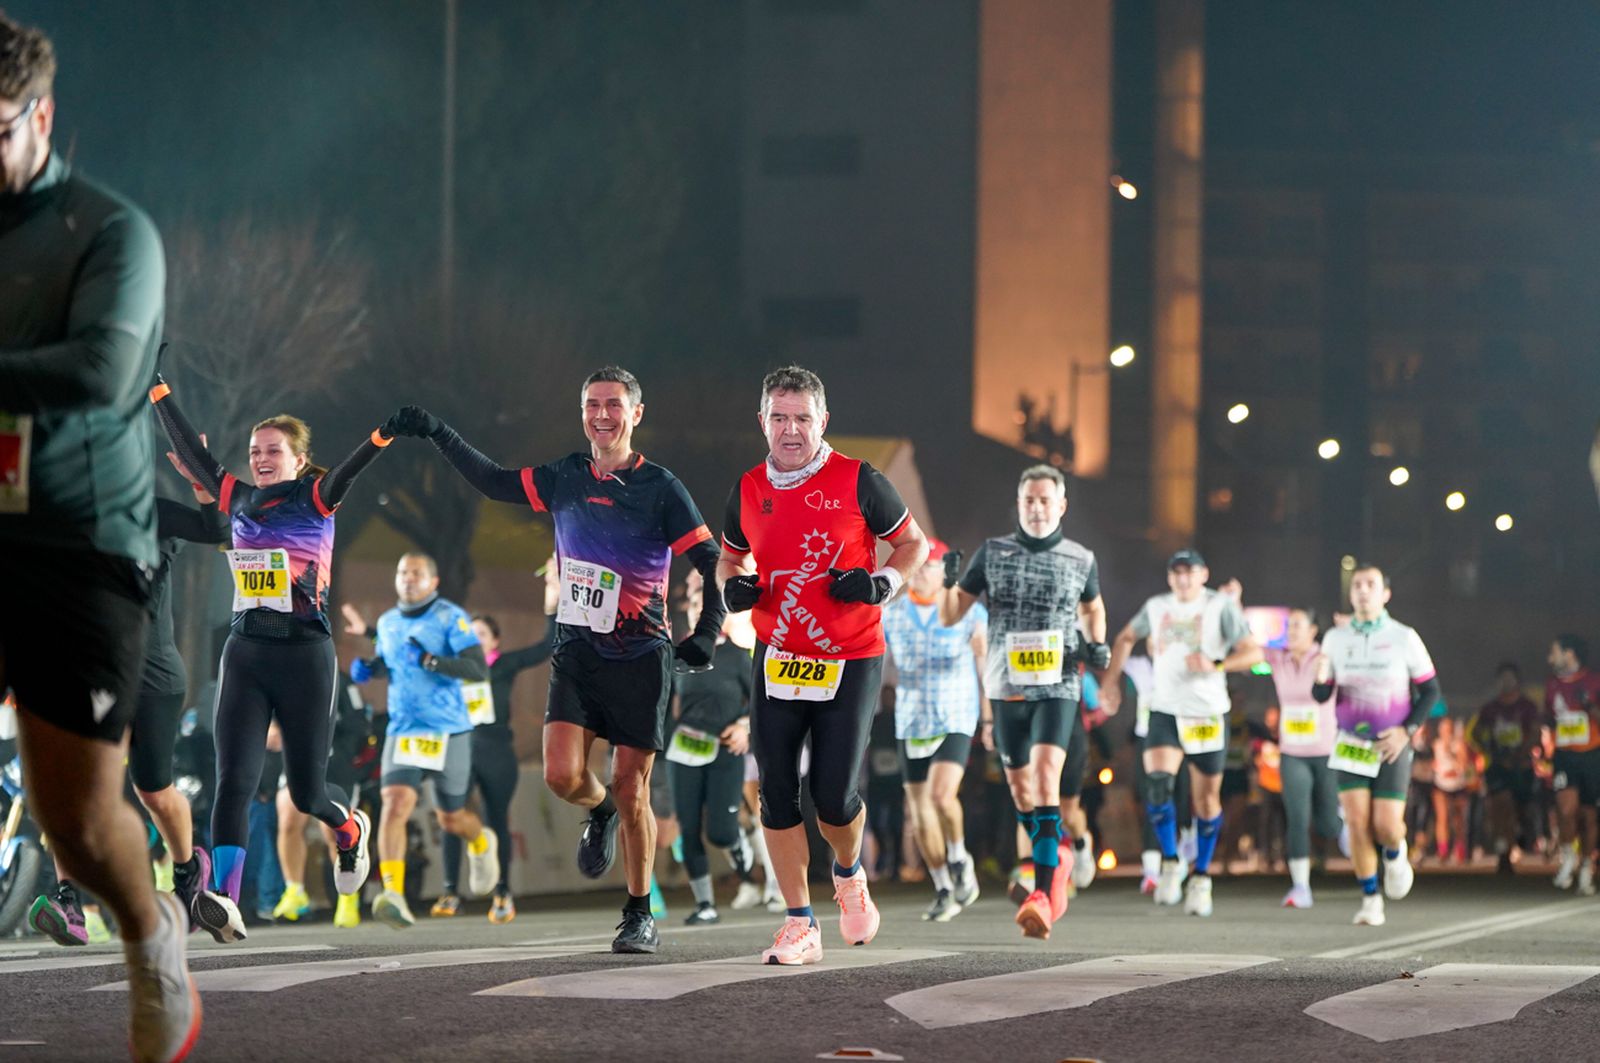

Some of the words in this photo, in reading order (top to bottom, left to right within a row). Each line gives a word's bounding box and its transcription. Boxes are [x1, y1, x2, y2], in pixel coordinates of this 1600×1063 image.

[241, 571, 276, 590] 7074
[770, 561, 818, 648] UNNING
[791, 606, 842, 654] RIVAS
[1017, 651, 1054, 667] 4404
[778, 661, 827, 681] 7028
